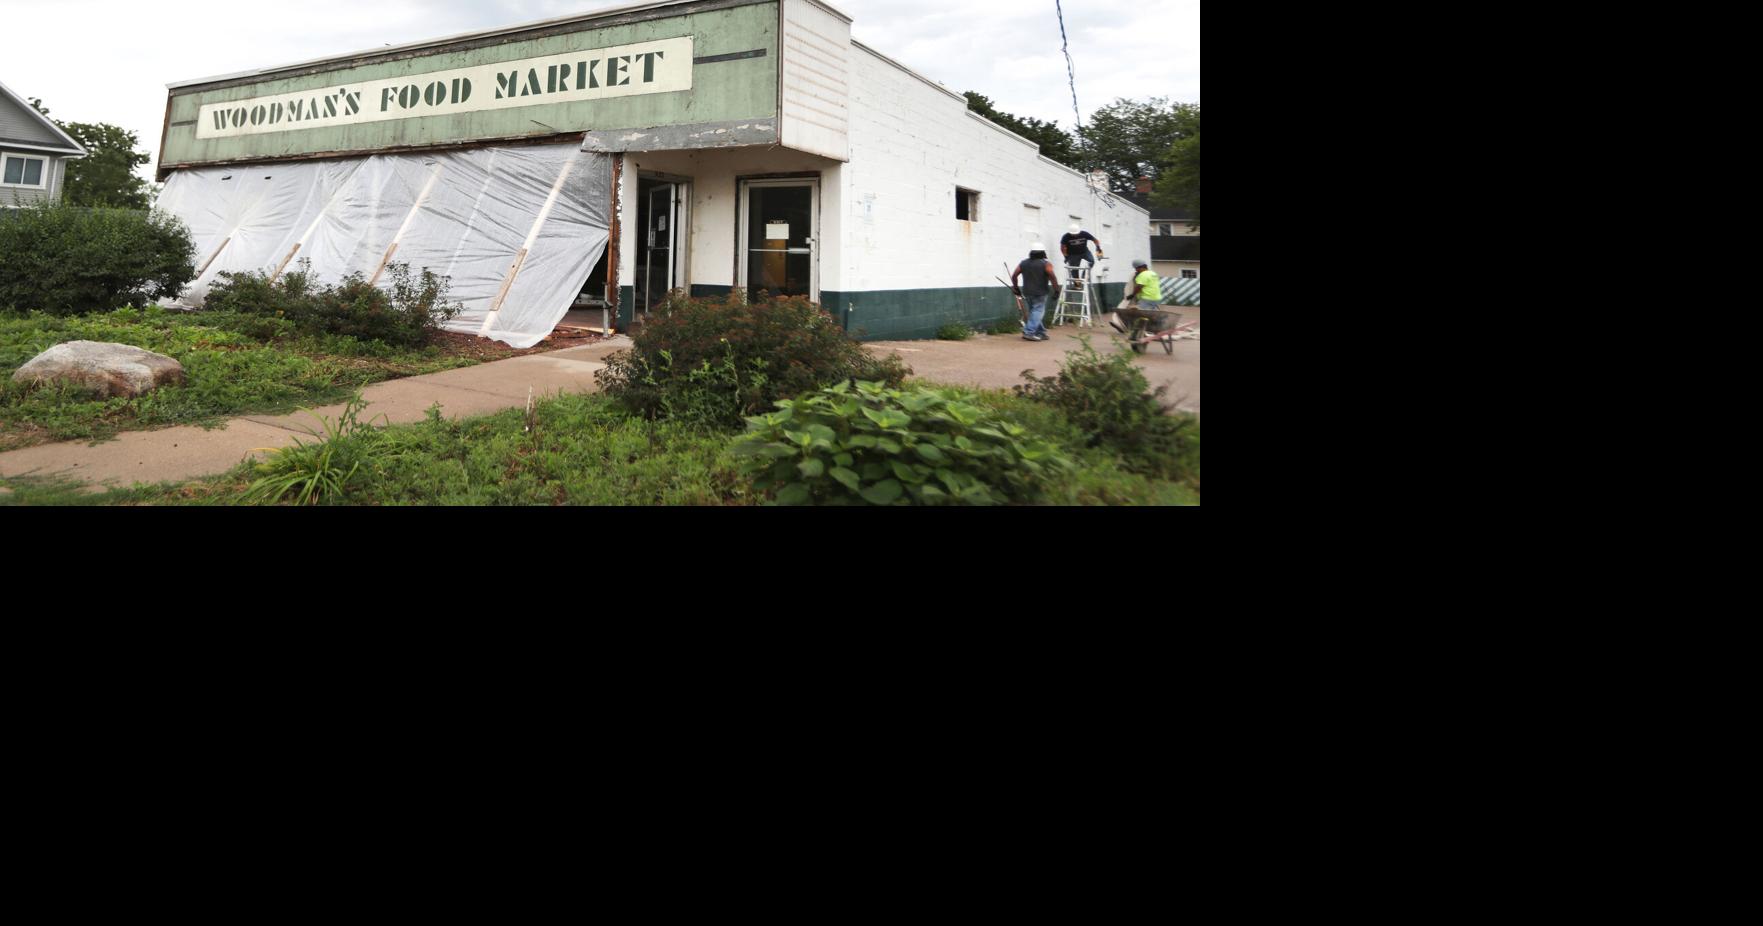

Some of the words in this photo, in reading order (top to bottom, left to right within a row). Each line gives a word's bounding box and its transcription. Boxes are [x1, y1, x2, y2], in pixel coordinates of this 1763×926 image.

[213, 87, 361, 130] WOODMAN'S
[380, 77, 472, 112] FOOD
[495, 51, 664, 100] MARKET
